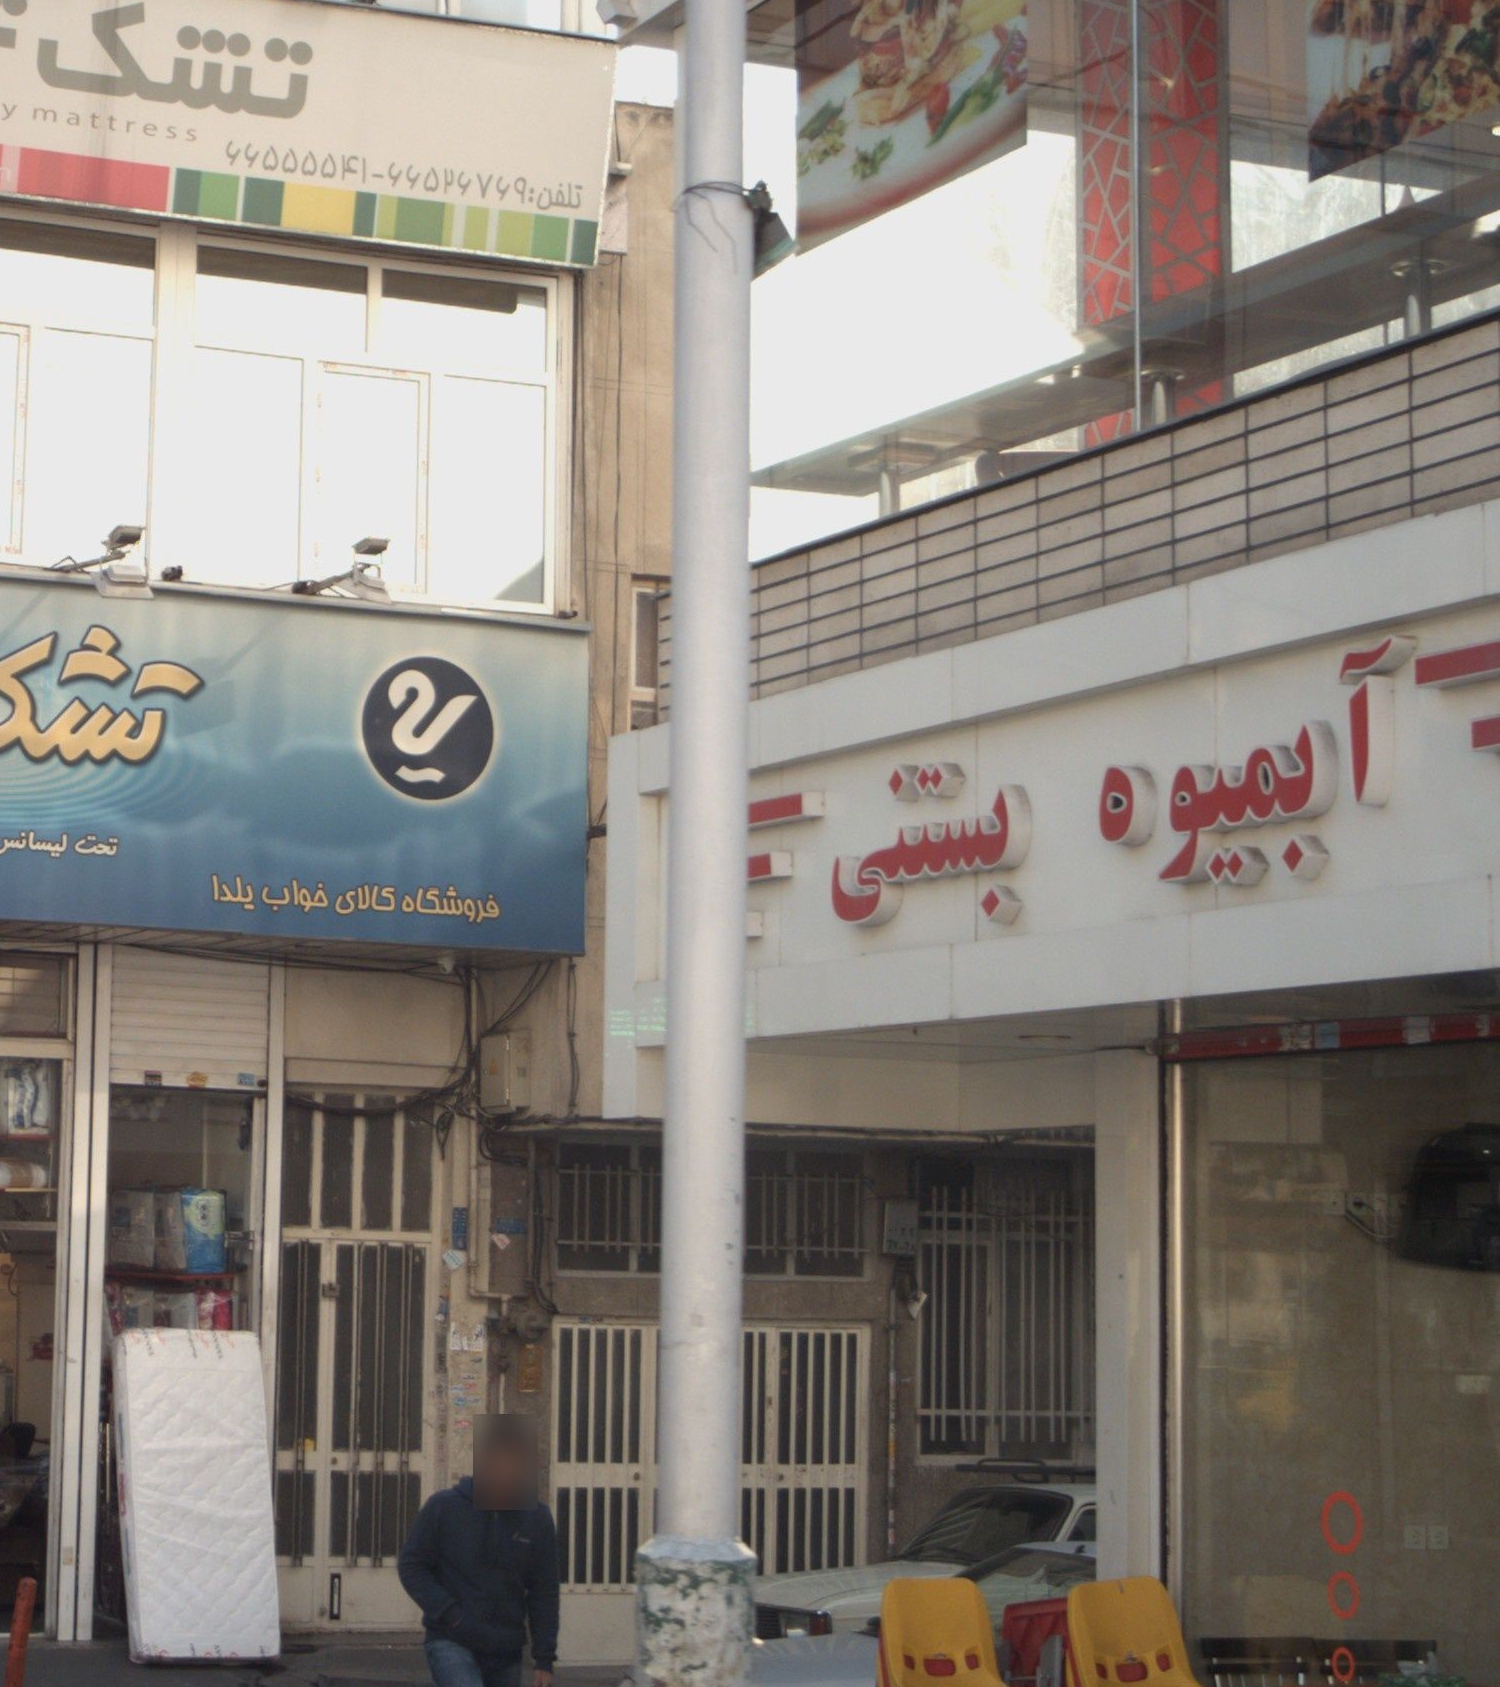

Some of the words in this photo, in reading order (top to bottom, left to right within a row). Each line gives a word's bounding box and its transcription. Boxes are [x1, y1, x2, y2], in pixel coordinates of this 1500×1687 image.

[36, 2, 313, 119] تشک
[32, 106, 199, 143] mattress
[1099, 636, 1410, 885] آبمیوه
[74, 833, 120, 857] تحت
[830, 762, 1028, 926] بستنی
[210, 873, 255, 911] یلدا
[260, 878, 329, 913] خواب
[334, 884, 397, 916] کالای
[400, 884, 501, 924] فروشگاه
